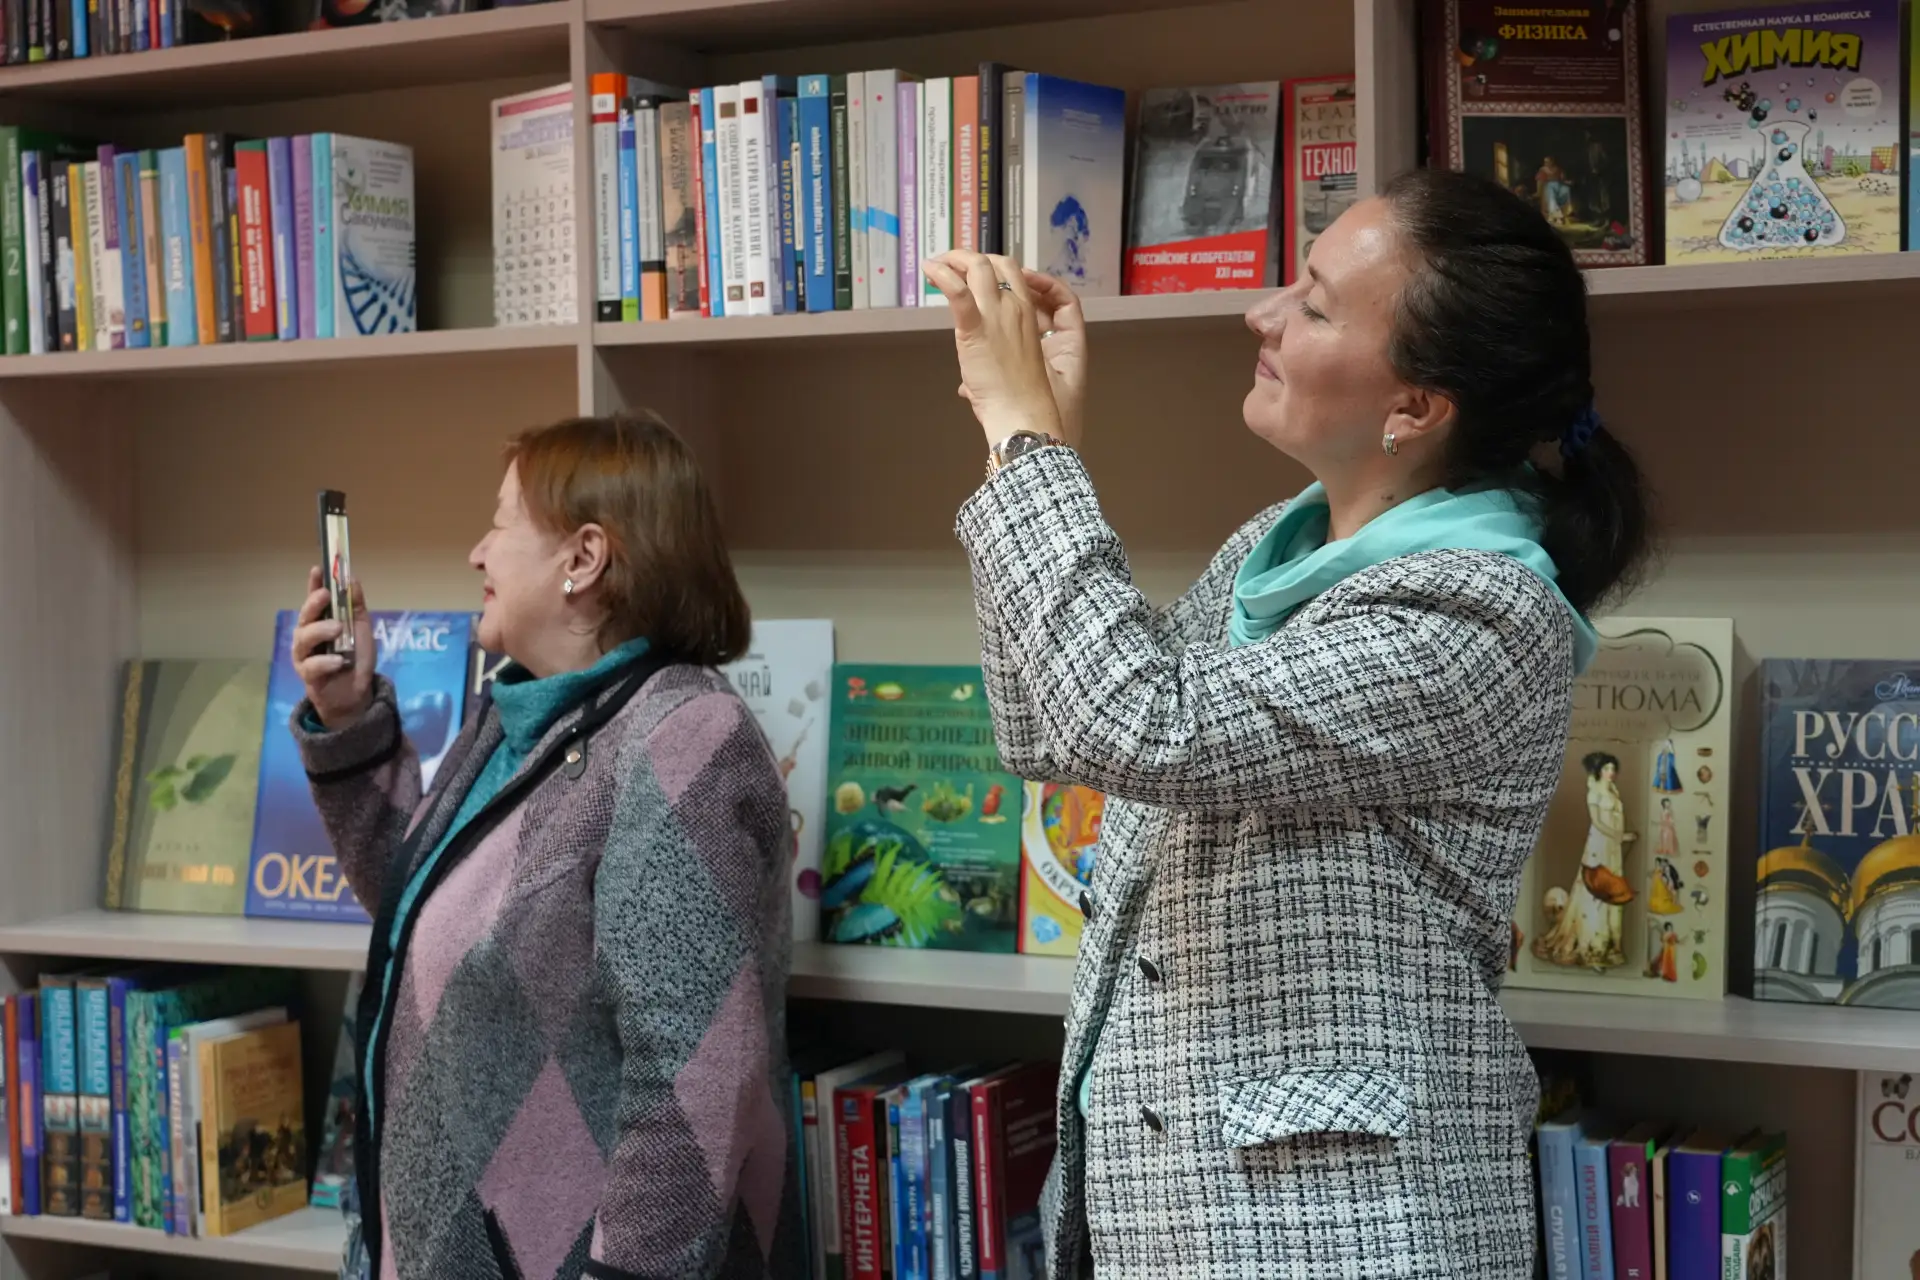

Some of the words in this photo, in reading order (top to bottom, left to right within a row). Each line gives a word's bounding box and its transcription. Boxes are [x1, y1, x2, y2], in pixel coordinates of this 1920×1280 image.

[1498, 24, 1588, 40] ФИЗИКА
[1693, 18, 1766, 33] ЕСТЕСТВЕННАЯ
[1767, 16, 1802, 27] НАУКА
[1804, 14, 1811, 23] В
[1812, 10, 1871, 22] КОМИКСАХ
[1700, 29, 1862, 86] ХИМИЯ
[1300, 102, 1356, 122] КРАТ
[1301, 123, 1356, 140] ИСТО
[1304, 146, 1356, 176] ТЕХНО
[781, 160, 792, 245] МЕТРОЛОГИЯ
[960, 201, 973, 251] ОВАРНАЯ
[1570, 683, 1702, 713] СТЮМА
[843, 723, 998, 745] ЭНЦИКЛОПЕДИ
[1791, 710, 1920, 761] РУСС
[917, 753, 1001, 773] ПРИРОД
[1789, 767, 1920, 837] ХРА
[255, 852, 350, 902] ОКЕ
[954, 1139, 969, 1209] ДОПОЛНЕННАЯ
[852, 1145, 874, 1272] ИНТЕРНЕТА
[958, 1212, 973, 1276] РЕАЛЬНОСТЬ
[1551, 1205, 1567, 1272] СЛУШАЯ
